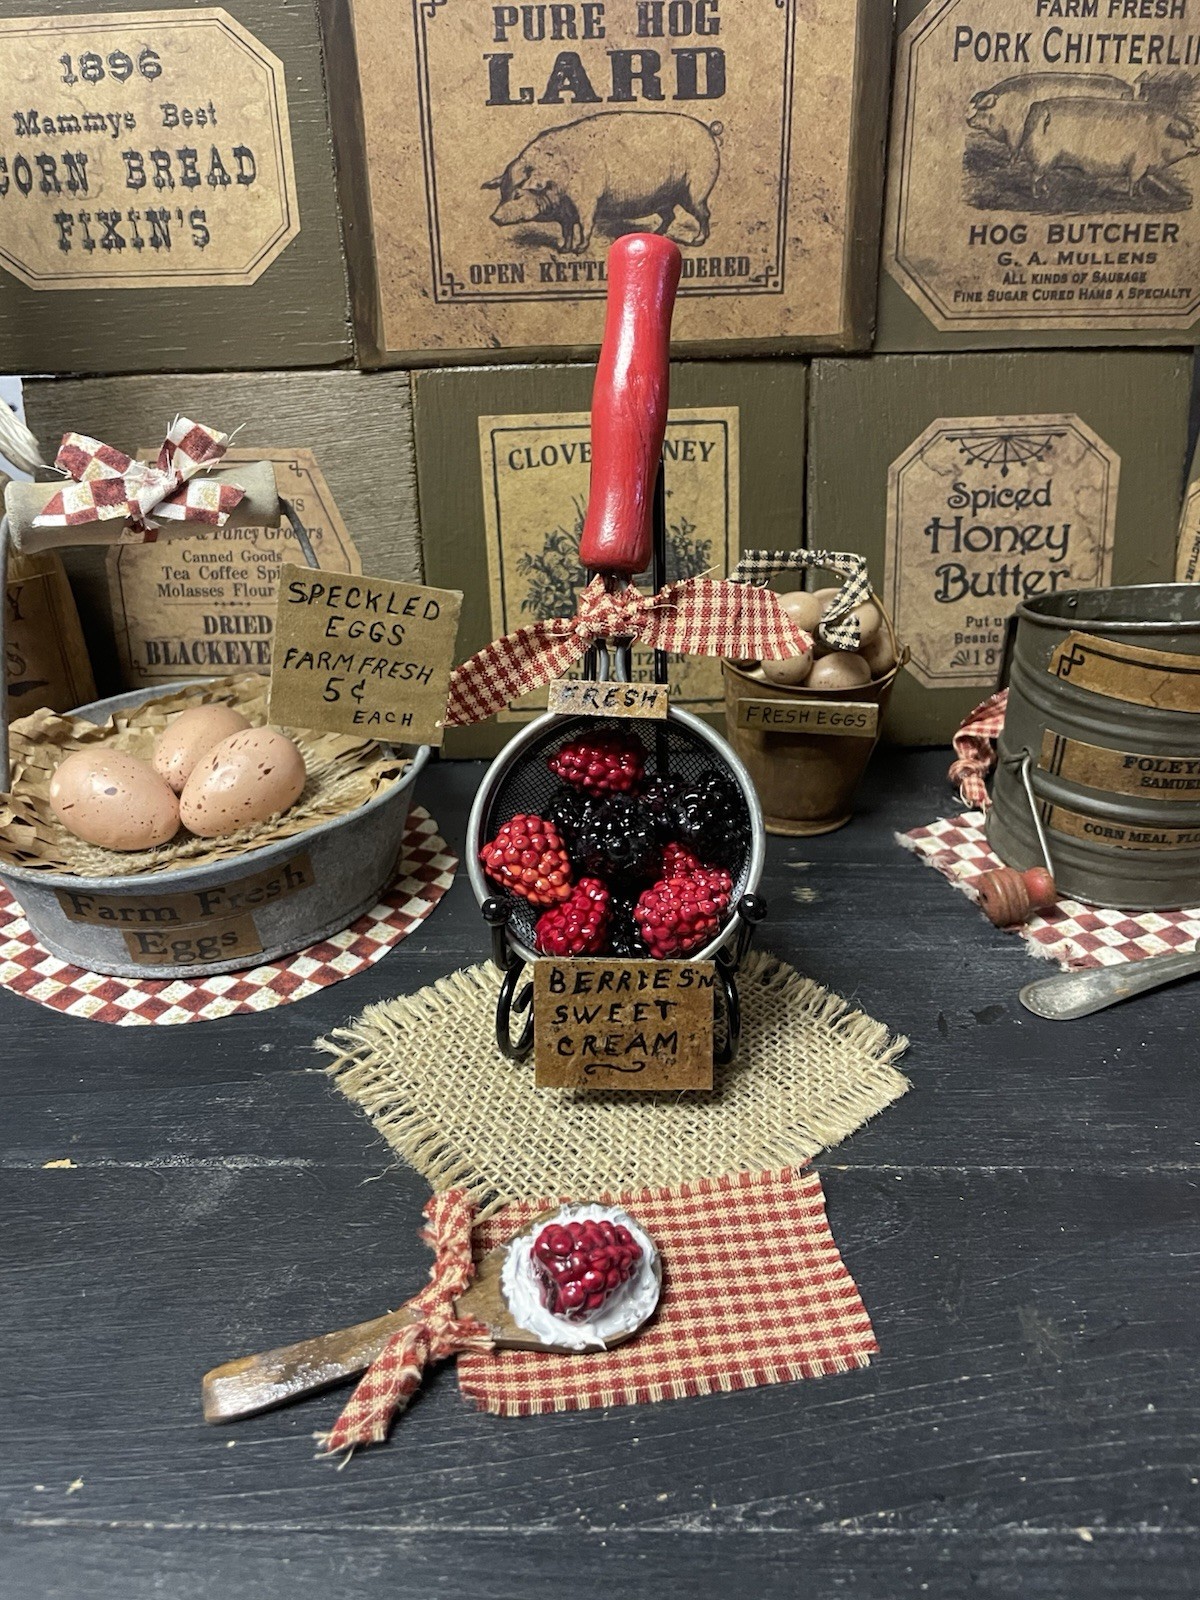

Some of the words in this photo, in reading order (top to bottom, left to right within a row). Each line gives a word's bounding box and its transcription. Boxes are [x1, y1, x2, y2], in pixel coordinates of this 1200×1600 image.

[492, 3, 606, 43] PURE
[635, 0, 721, 38] HOG
[1035, 0, 1098, 19] FARM
[1107, 0, 1187, 19] FRESH
[952, 25, 1032, 63] PORK
[1043, 26, 1200, 66] CHITTERLI
[58, 48, 163, 87] 1896
[482, 46, 727, 107] LARD
[11, 107, 137, 139] Mammys
[159, 99, 218, 131] Best
[121, 143, 258, 194] BREAD
[53, 205, 211, 256] FIXIN'S
[968, 224, 1028, 246] HOG
[1046, 222, 1180, 244] BUTCHER
[468, 263, 526, 285] OPEN
[539, 260, 607, 283] KETTL
[682, 255, 751, 279] DERED
[508, 442, 592, 471] CLOVE
[662, 439, 716, 462] NEY
[947, 479, 1053, 518] Spiced
[924, 516, 1071, 563] Honey
[182, 549, 233, 563] Canned
[241, 549, 283, 563] Goods
[161, 566, 190, 581] Tea
[199, 565, 248, 581] Coffee
[934, 562, 1070, 604] Butter
[157, 583, 225, 598] Molasses
[233, 582, 275, 598] Flour
[288, 582, 441, 621] SPECKLED
[203, 614, 273, 635] DRIED
[325, 615, 406, 646] EGGS
[561, 685, 660, 710] FRESH
[352, 710, 413, 727] EACH
[746, 705, 810, 724] FRESH
[816, 711, 867, 728] EGGS
[1122, 755, 1200, 775] FOLEY
[1083, 823, 1126, 841] CORN
[65, 892, 181, 922] Farm
[194, 863, 307, 917] Fresh
[132, 930, 239, 963] Eggs
[551, 999, 678, 1025] SWEET
[557, 1030, 679, 1056] CREAM
